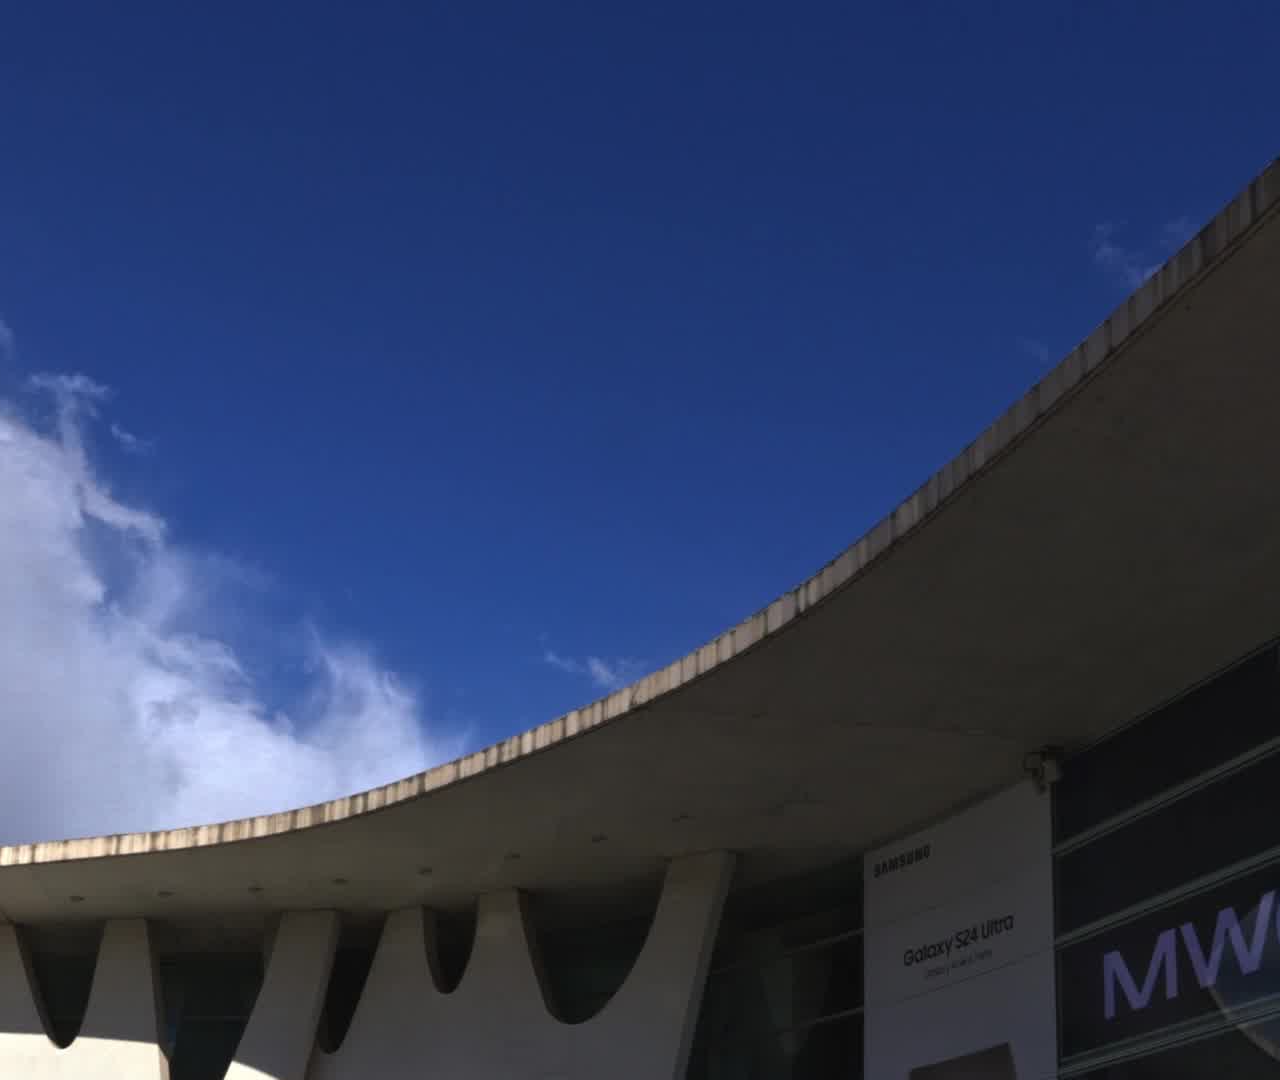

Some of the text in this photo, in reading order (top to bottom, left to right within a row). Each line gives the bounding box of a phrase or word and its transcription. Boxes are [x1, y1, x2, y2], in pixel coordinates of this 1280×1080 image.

[874, 844, 931, 878] SAMSUNG
[903, 936, 954, 967] Galaxy
[954, 926, 979, 950] S24
[980, 914, 1015, 940] Ultra
